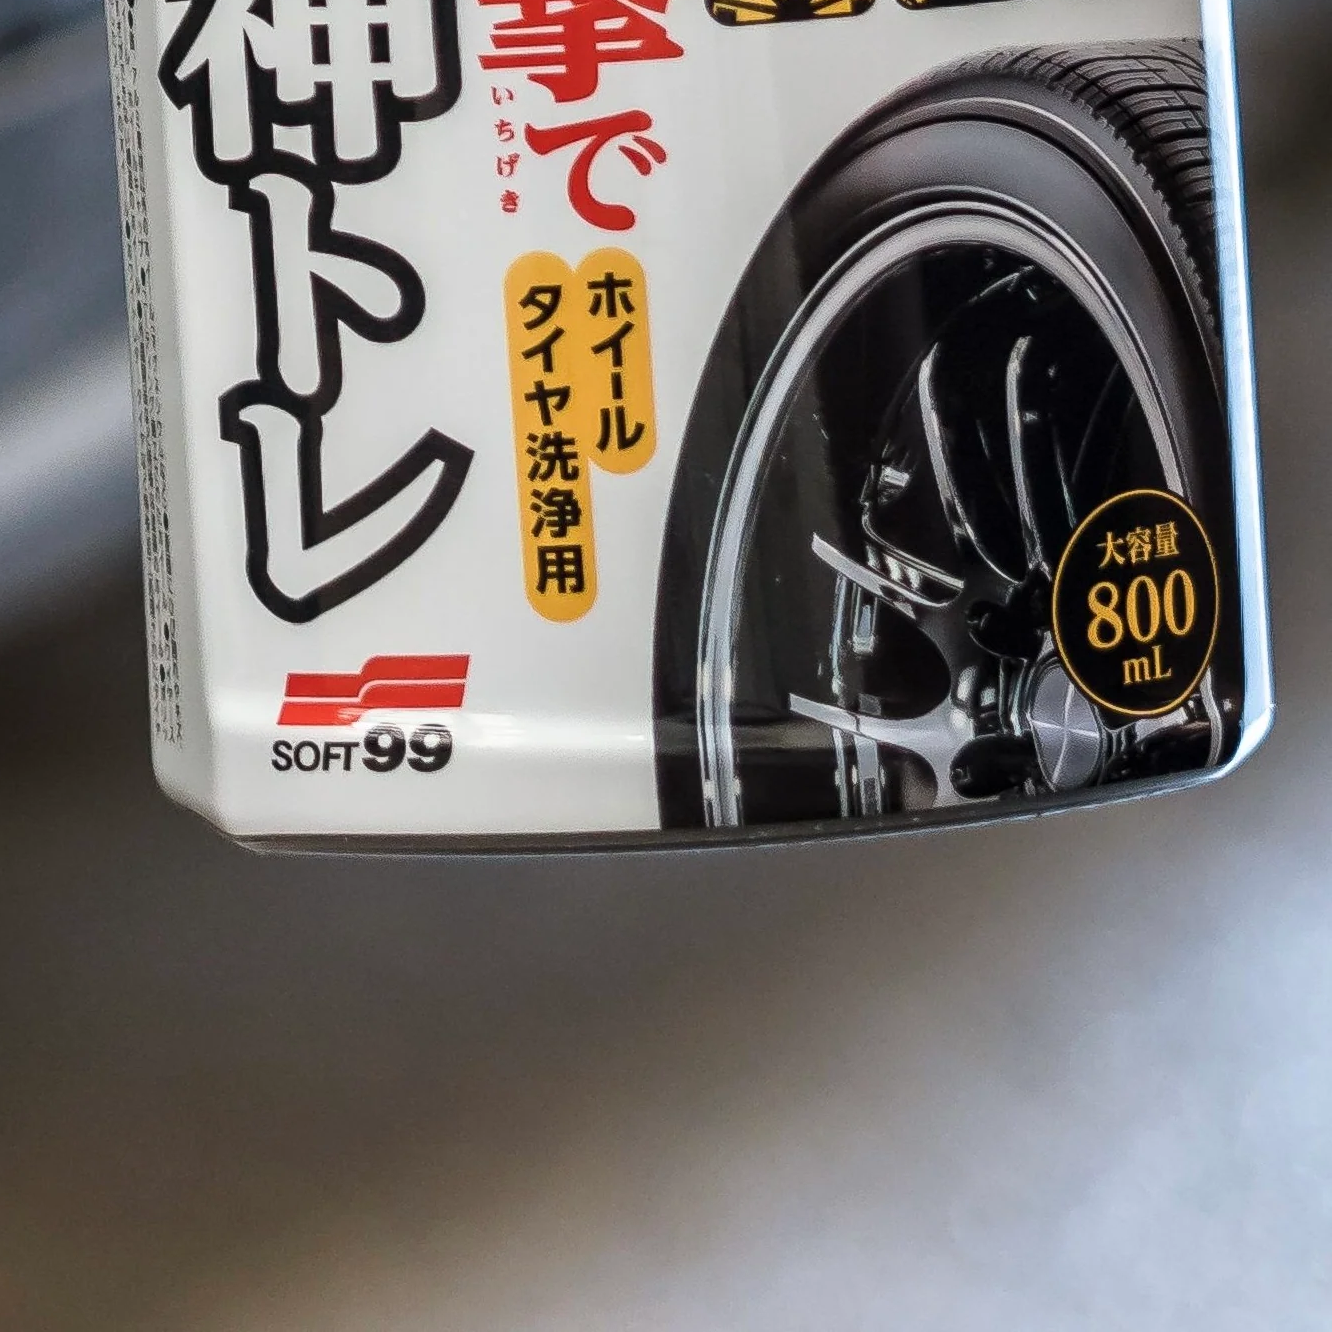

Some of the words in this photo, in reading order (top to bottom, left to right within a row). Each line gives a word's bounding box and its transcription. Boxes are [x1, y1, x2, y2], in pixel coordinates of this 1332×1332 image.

[491, 86, 520, 213] いちげき
[587, 271, 645, 454] ホイール
[519, 284, 585, 594] タイヤ洗浄用
[1097, 521, 1180, 569] 大容量
[1087, 569, 1195, 649] 800
[1122, 645, 1172, 685] mL
